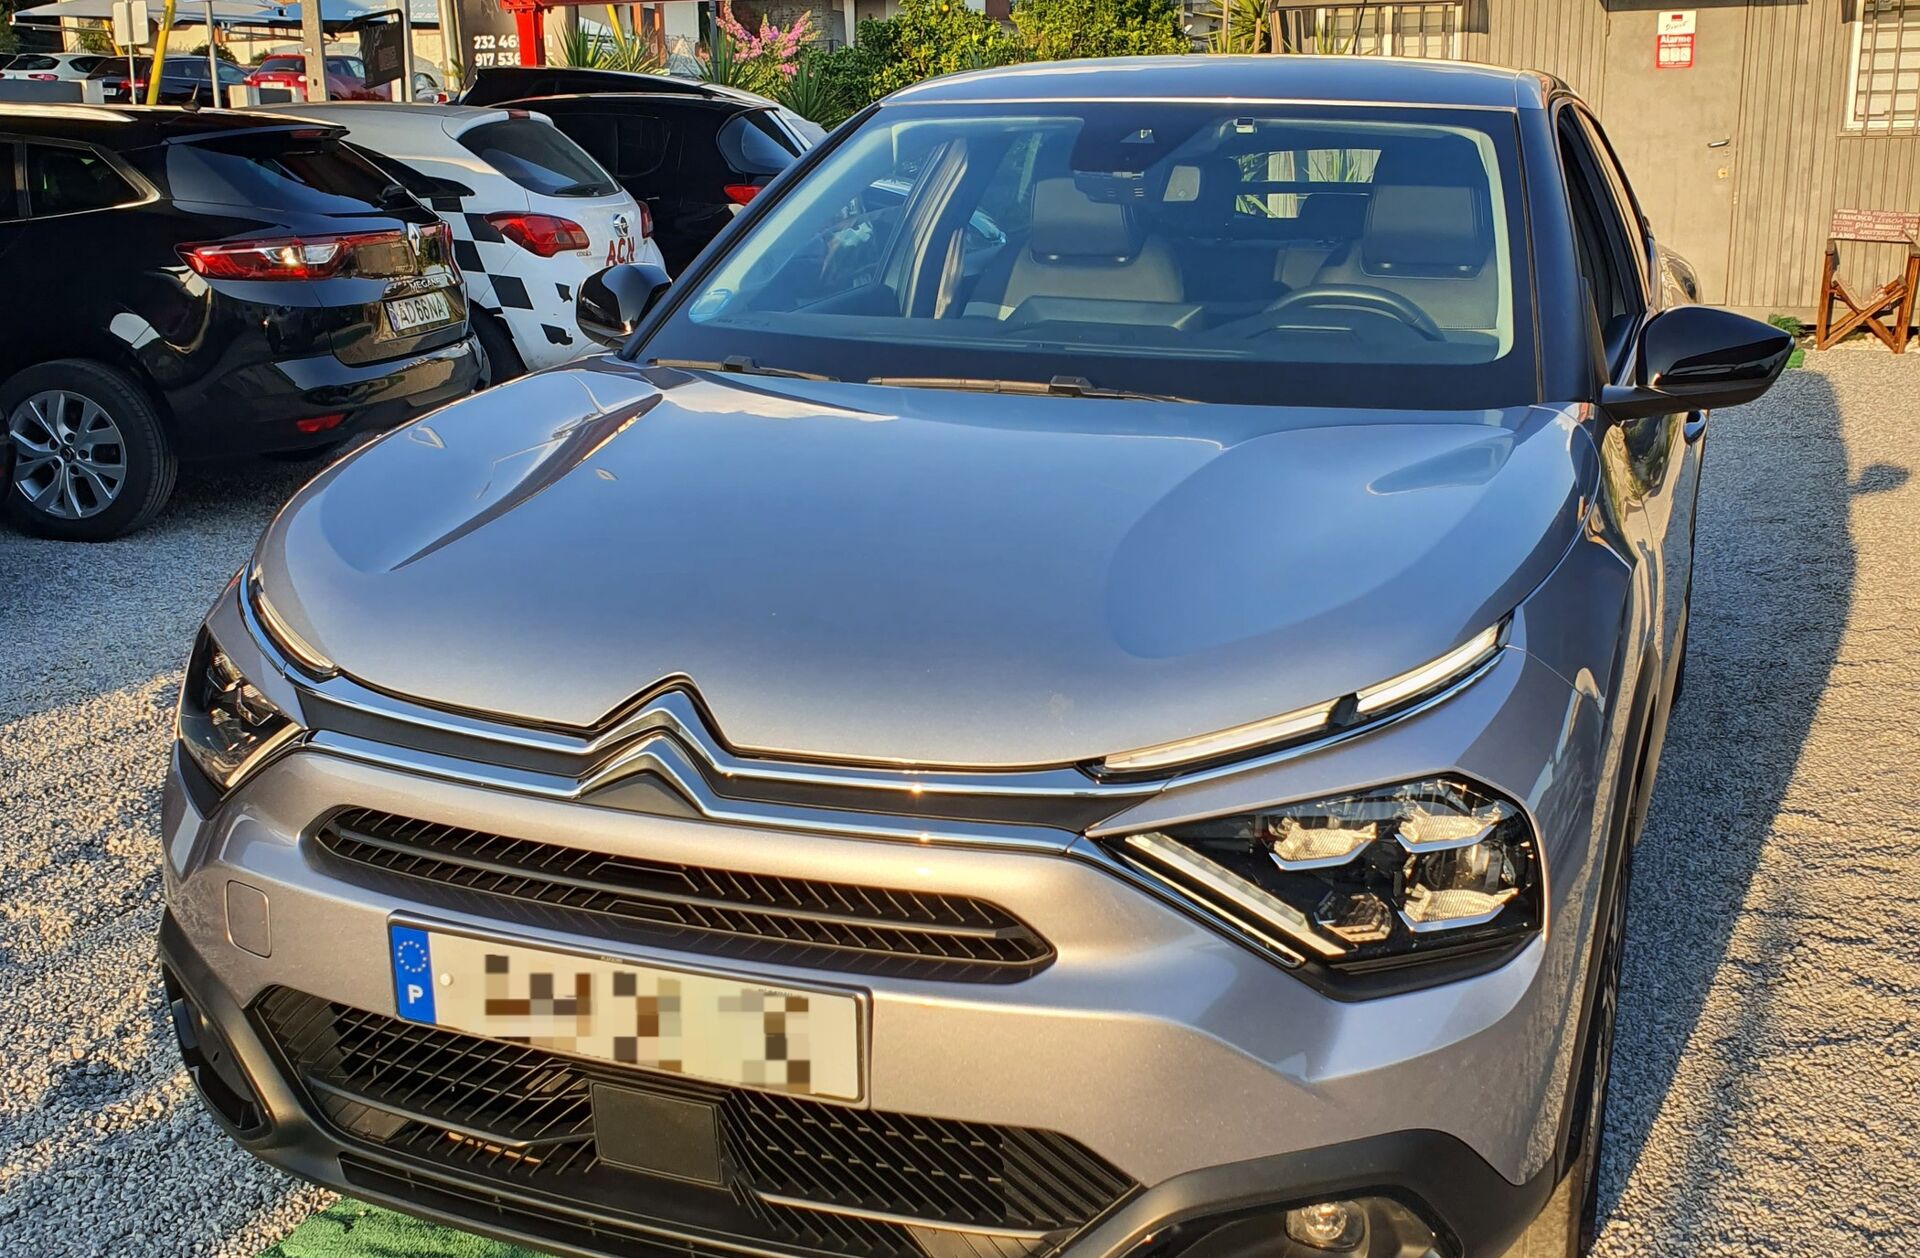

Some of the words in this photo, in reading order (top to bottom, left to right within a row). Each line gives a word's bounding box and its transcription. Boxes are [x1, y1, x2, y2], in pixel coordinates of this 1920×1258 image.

[473, 35, 496, 49] 232
[1660, 34, 1692, 44] Alarme
[474, 53, 495, 67] 917
[1839, 213, 1873, 222] FRANCISCO
[606, 236, 635, 266] ACN
[408, 984, 423, 1004] P
